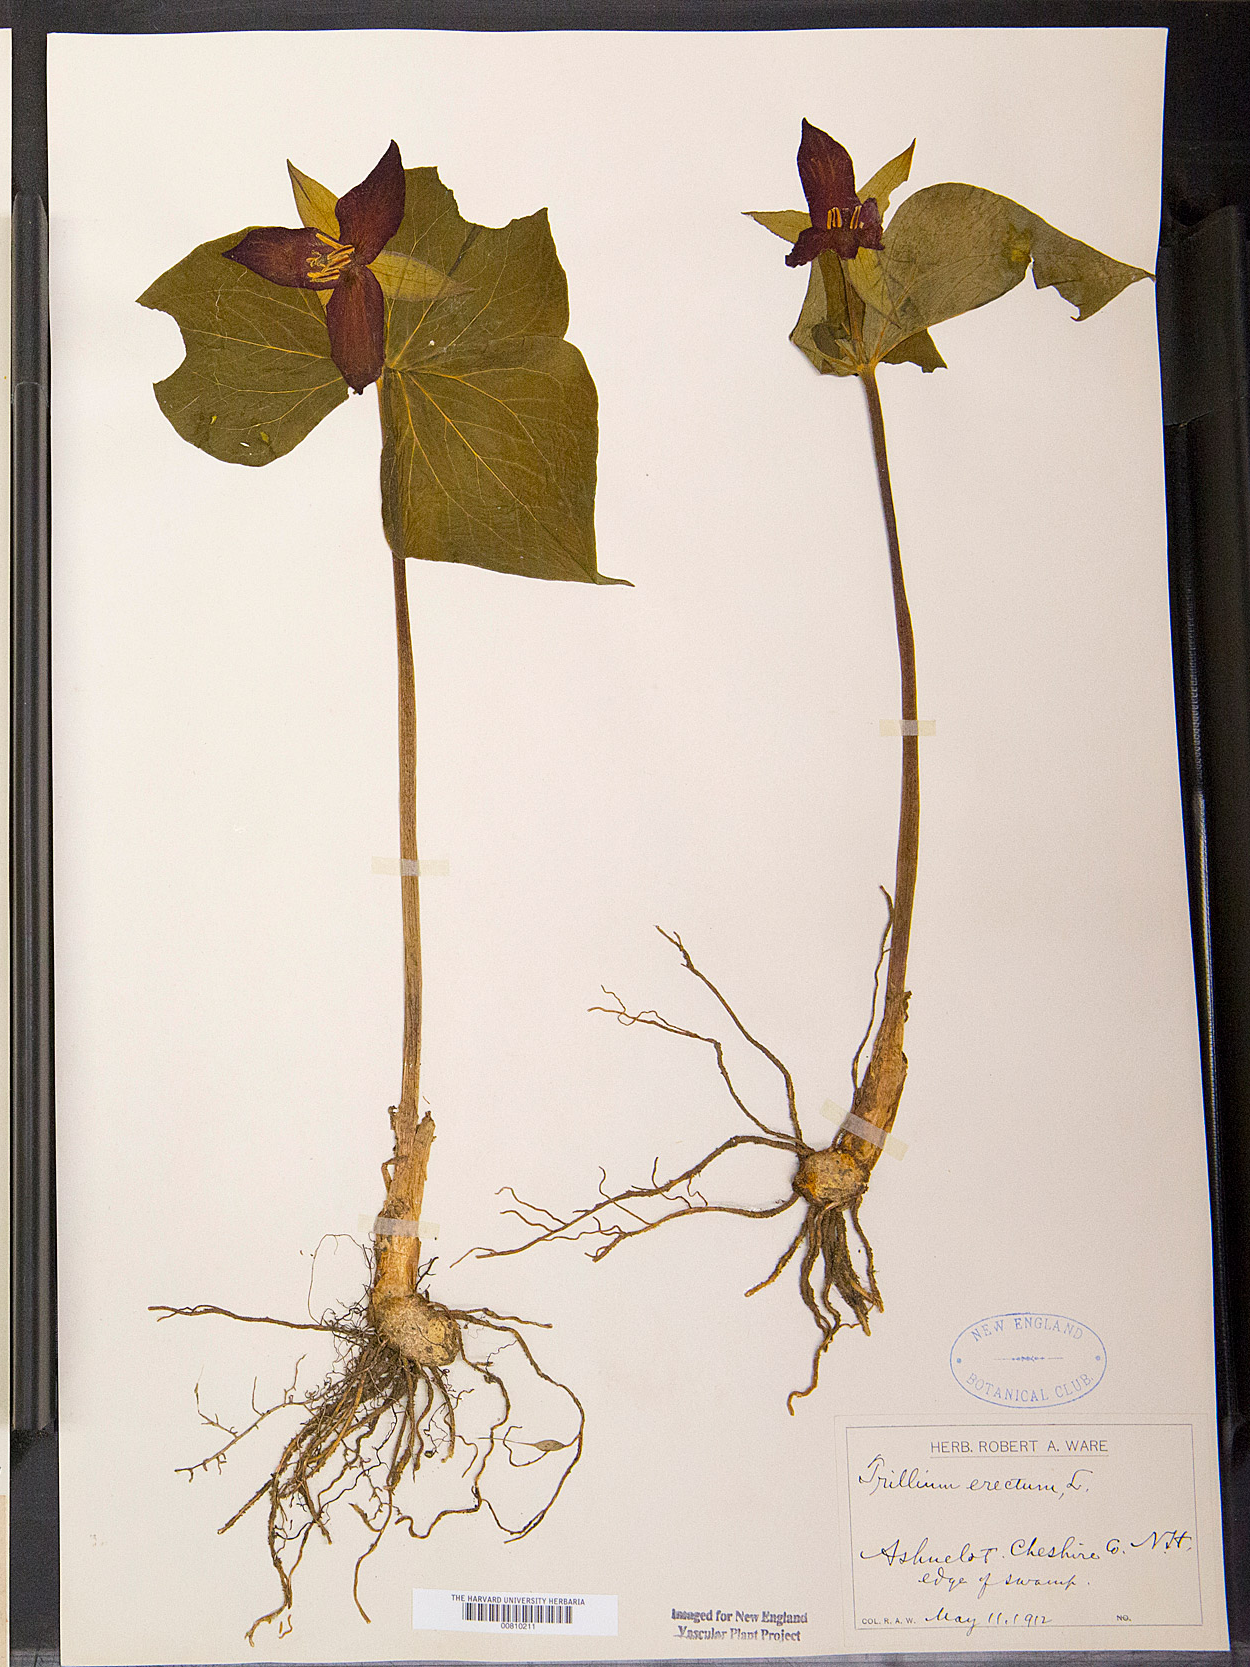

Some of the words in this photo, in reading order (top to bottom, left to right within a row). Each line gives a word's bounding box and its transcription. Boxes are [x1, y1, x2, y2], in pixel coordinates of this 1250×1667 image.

[970, 1319, 1004, 1342] NEW
[1014, 1317, 1083, 1340] ENGLAND
[966, 1373, 1049, 1402] BOTANICAL
[930, 1441, 974, 1453] HERB.
[978, 1440, 1038, 1453] ROBERT
[1047, 1440, 1060, 1452] A.
[1065, 1440, 1109, 1452] WARE
[858, 1454, 961, 1495] Trillium
[1010, 1536, 1100, 1559] Cheshire
[918, 1566, 968, 1591] edge
[978, 1572, 1004, 1599] of
[451, 1594, 465, 1602] THE
[467, 1595, 502, 1603] HARVARD
[504, 1597, 547, 1605] UNIVERSITY
[548, 1598, 586, 1606] HERBARIA
[671, 1608, 713, 1624] Imaged
[715, 1609, 733, 1622] for
[735, 1610, 759, 1623] New
[761, 1611, 808, 1627] England
[861, 1617, 882, 1625] COL.
[883, 1616, 893, 1625] R.
[894, 1616, 905, 1624] A.
[906, 1616, 917, 1624] W.
[925, 1607, 980, 1636] May
[1116, 1614, 1132, 1622] NO.
[677, 1625, 727, 1641] Vascular
[730, 1628, 758, 1641] Plant
[761, 1629, 801, 1642] Project
